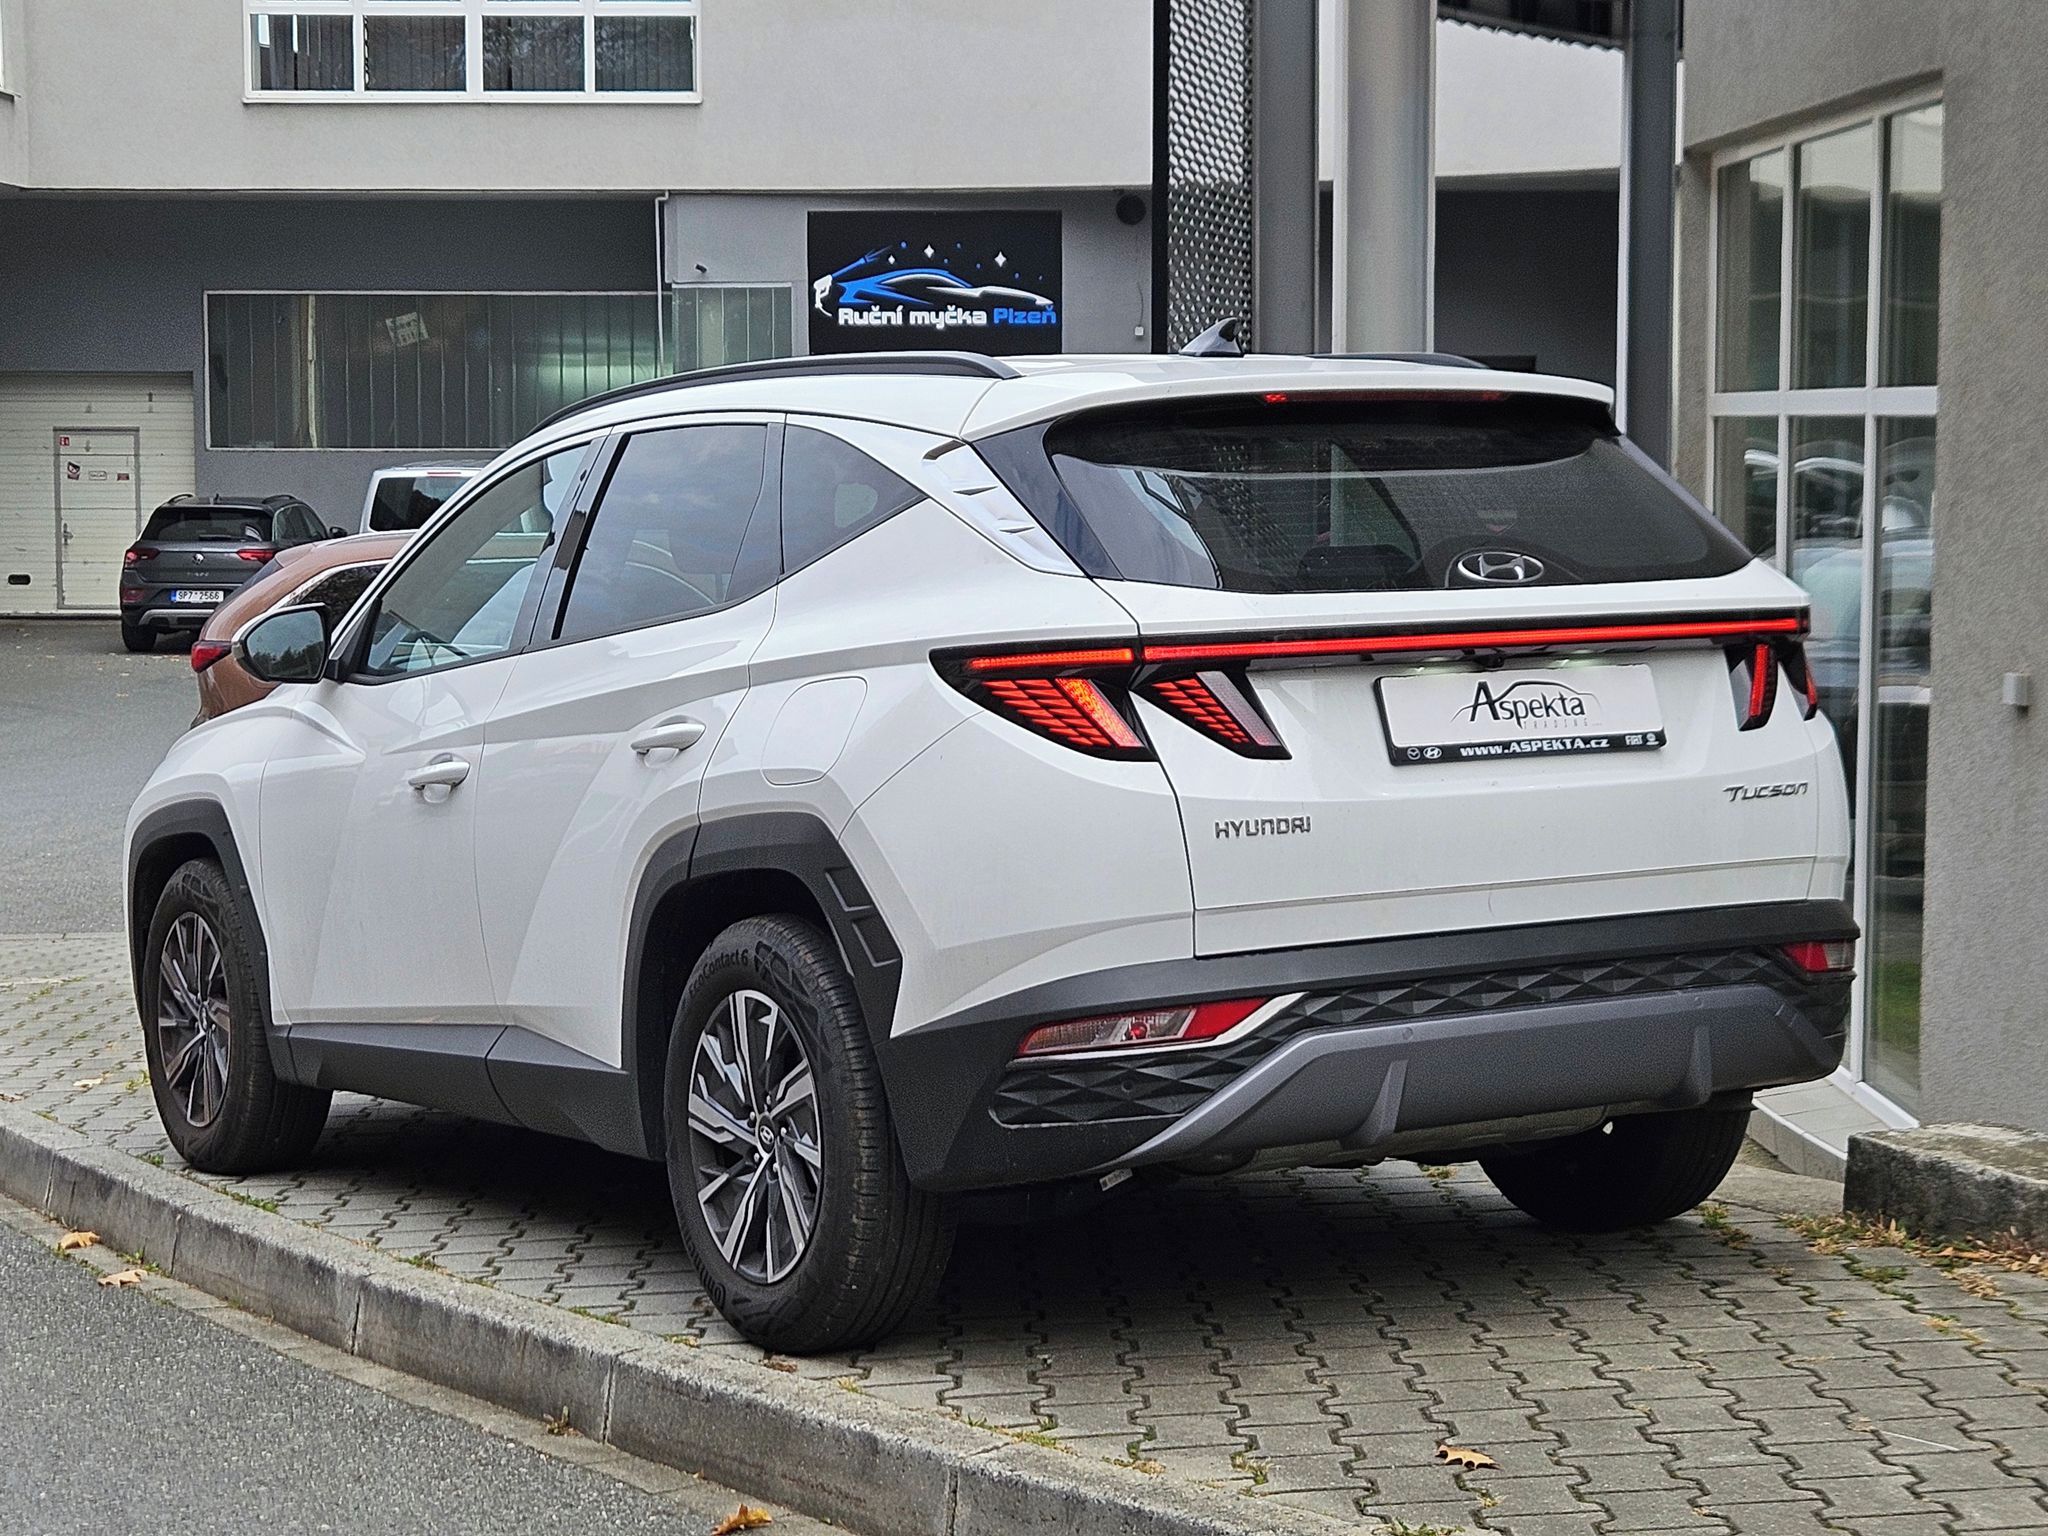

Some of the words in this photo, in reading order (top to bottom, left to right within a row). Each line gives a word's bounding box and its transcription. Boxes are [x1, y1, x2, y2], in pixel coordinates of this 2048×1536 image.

[838, 305, 903, 326] Ruční
[909, 305, 987, 330] myčka
[993, 305, 1057, 325] Plzeň
[1470, 681, 1586, 730] Aspekta
[1459, 737, 1610, 757] www.ASPEKTA.cz
[1215, 816, 1311, 839] HYUNDAI
